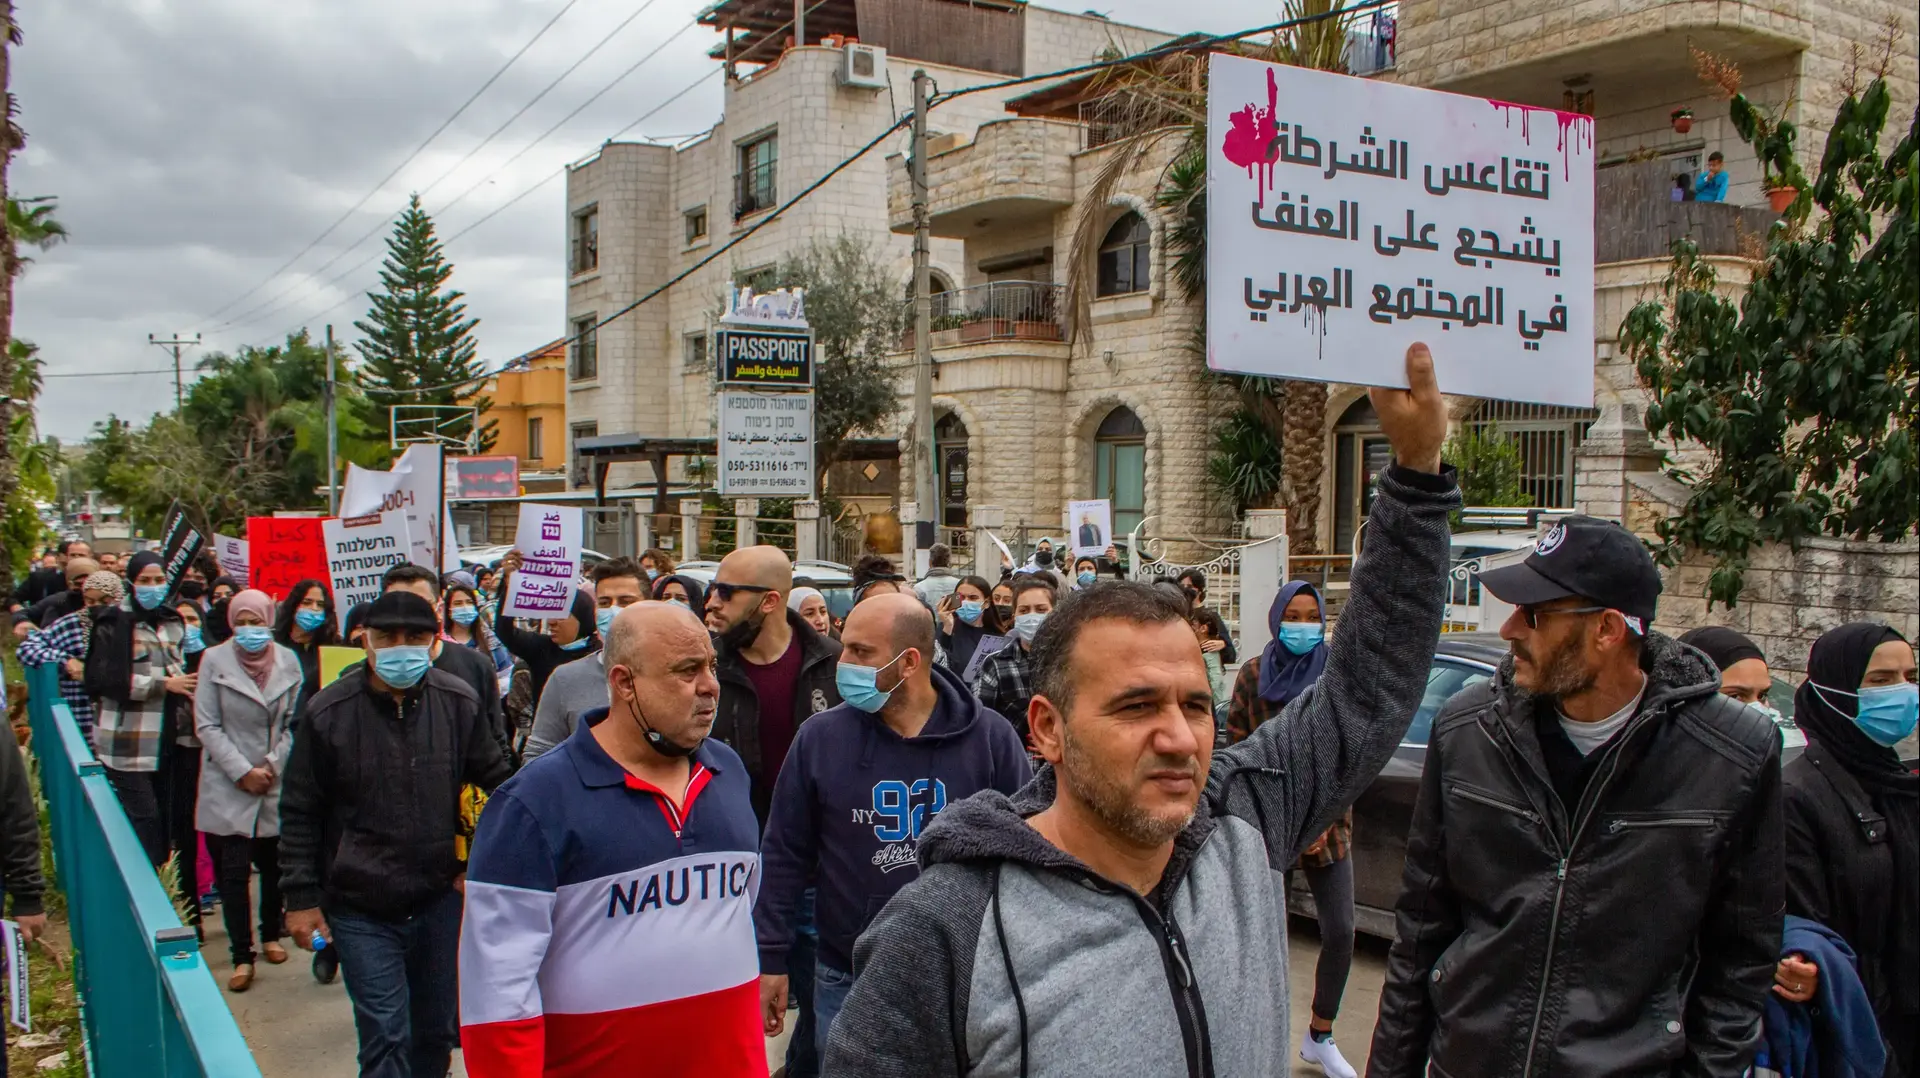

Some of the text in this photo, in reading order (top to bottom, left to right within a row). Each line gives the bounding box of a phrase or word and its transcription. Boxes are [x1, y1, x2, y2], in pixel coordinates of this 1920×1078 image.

[1264, 121, 1550, 200] تقاعس الشرطة
[1252, 192, 1561, 277] يشجع على العنف
[1244, 267, 1568, 351] في المجتمع العربي
[728, 336, 808, 362] PASSPORT
[735, 364, 766, 379] والسفر
[744, 416, 794, 431] סוכן ביטוח
[728, 460, 788, 471] 050-5311616
[543, 511, 560, 521] ضد
[543, 525, 560, 537] נגד
[336, 535, 396, 554] הרשלנות
[533, 546, 566, 559] العنف
[331, 552, 406, 572] המשטרתית
[520, 561, 572, 576] האלימות
[334, 576, 356, 590] את
[521, 577, 568, 596] والجريمة
[516, 594, 566, 608] והפשיעה
[851, 778, 947, 843] NY 92
